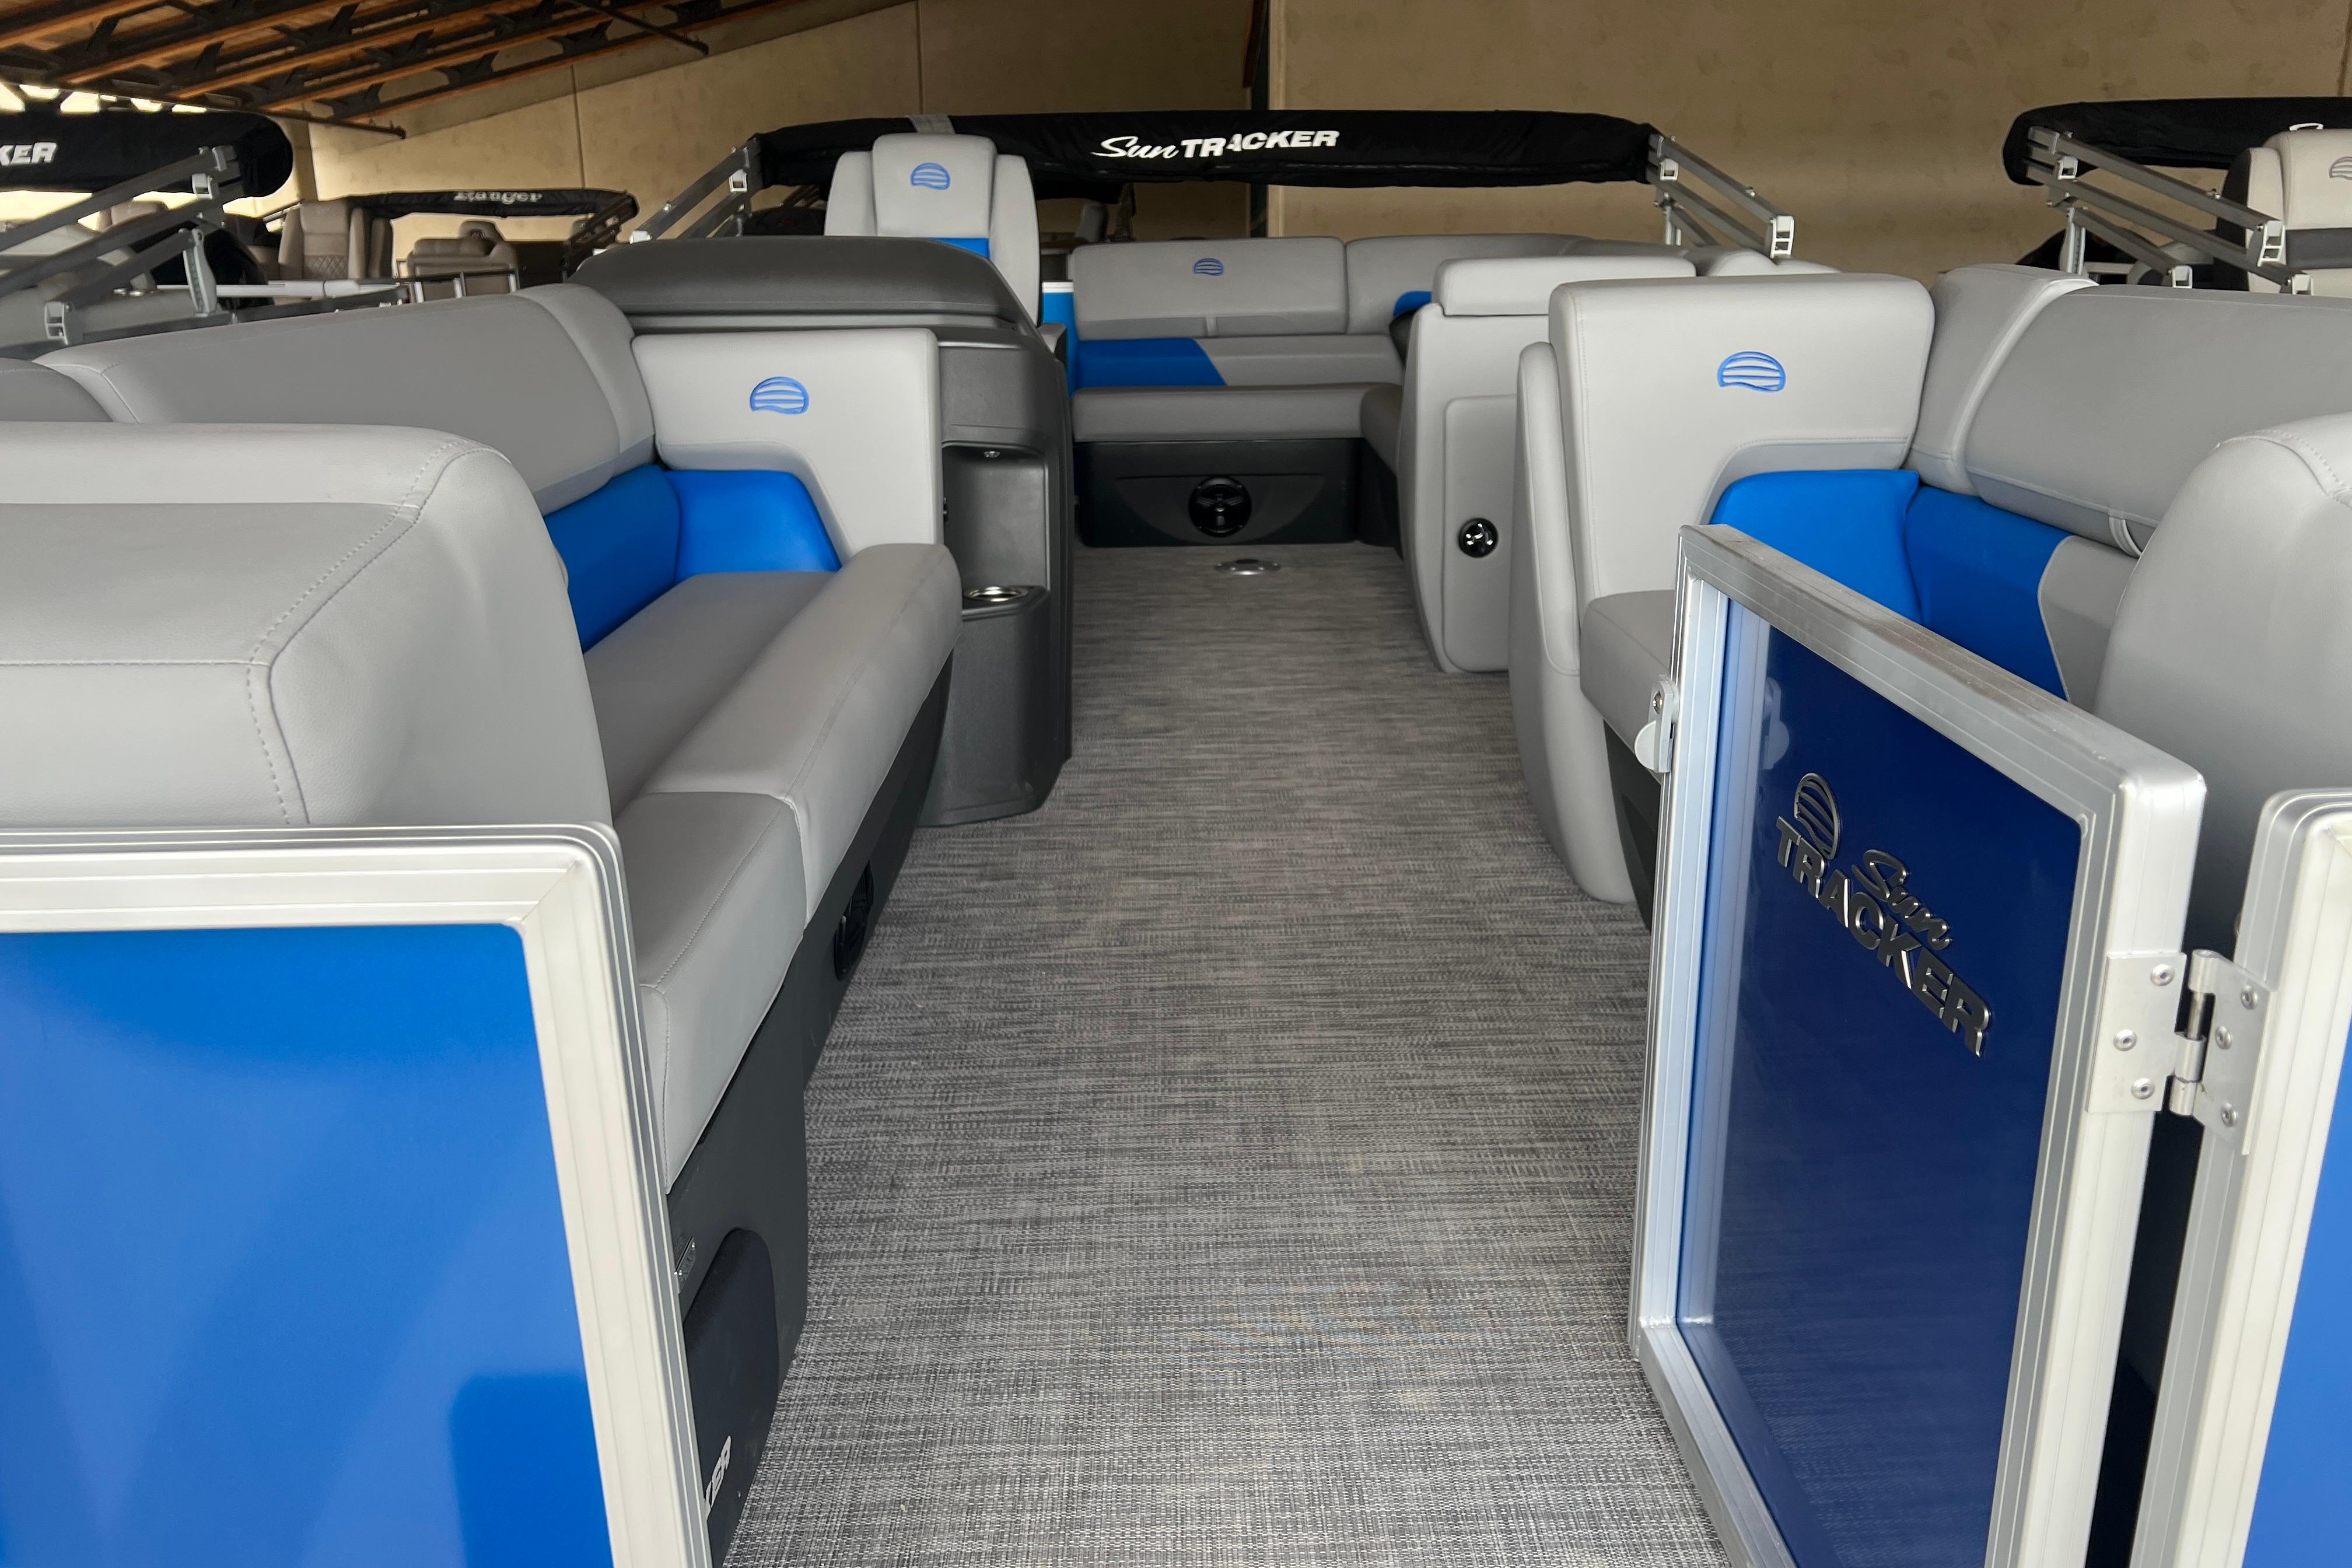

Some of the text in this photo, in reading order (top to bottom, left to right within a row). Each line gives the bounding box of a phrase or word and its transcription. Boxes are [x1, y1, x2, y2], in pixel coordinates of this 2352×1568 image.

[1090, 130, 1340, 159] Sun TRACKER
[1776, 816, 1992, 1058] TRACKER
[1851, 849, 1953, 950] Sun
